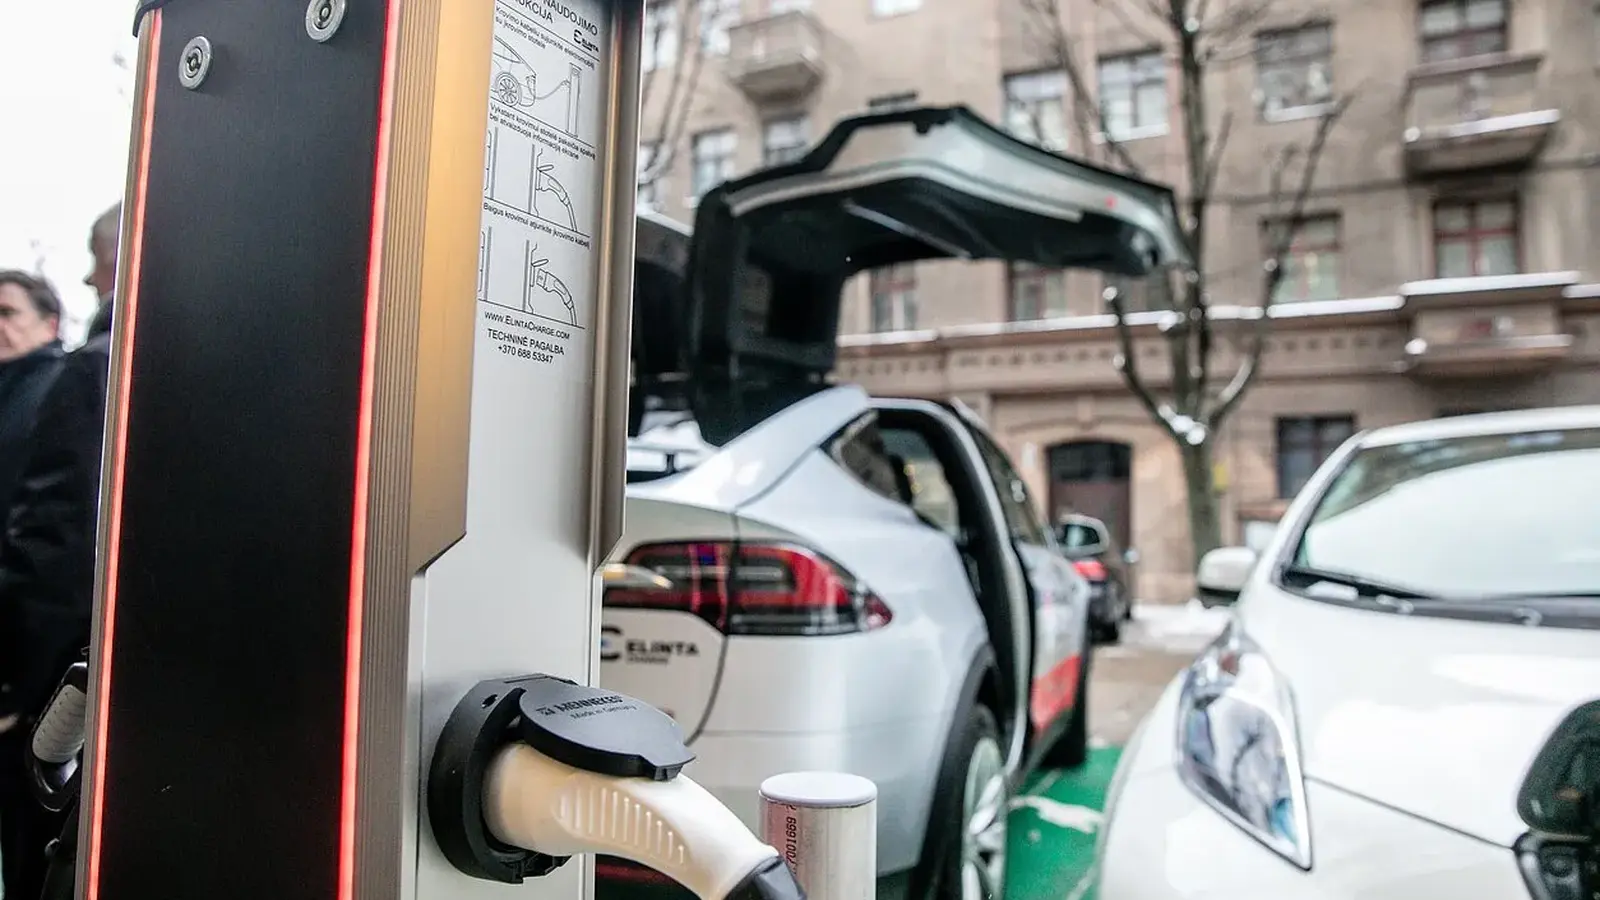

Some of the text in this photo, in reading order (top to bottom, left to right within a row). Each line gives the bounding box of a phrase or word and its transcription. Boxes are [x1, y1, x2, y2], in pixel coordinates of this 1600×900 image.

[515, 0, 553, 24] UKCIJA
[487, 328, 565, 356] TECHNINĖ PAGALBA
[498, 345, 554, 364] +370 688 53347
[626, 640, 699, 656] ELINTA
